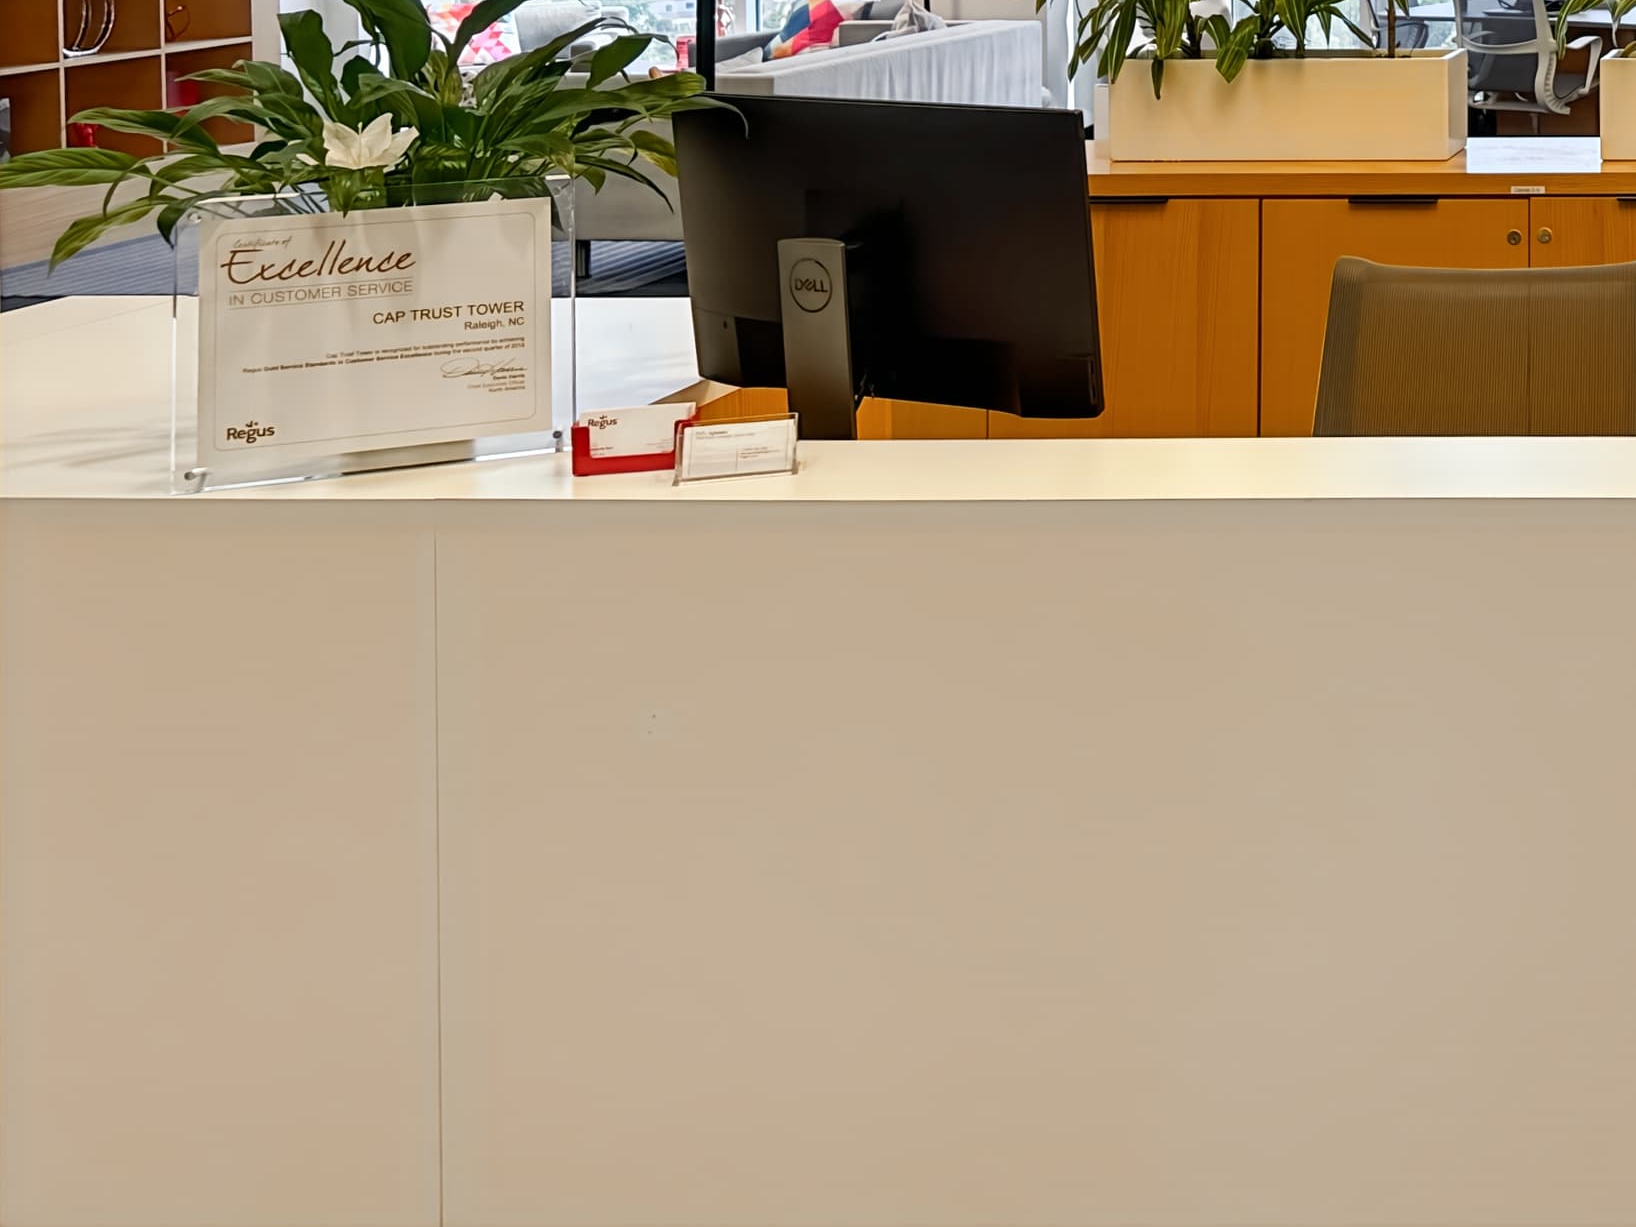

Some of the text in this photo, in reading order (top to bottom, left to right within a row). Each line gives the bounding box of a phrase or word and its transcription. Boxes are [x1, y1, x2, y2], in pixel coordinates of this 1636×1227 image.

[220, 239, 416, 285] Excellence
[229, 280, 414, 306] IN CUSTOMER SERVICE
[795, 278, 828, 293] DELL
[373, 300, 525, 324] CAP TRUST TOWER
[508, 316, 525, 326] NC
[588, 417, 618, 430] Regus
[227, 426, 275, 444] Regus
